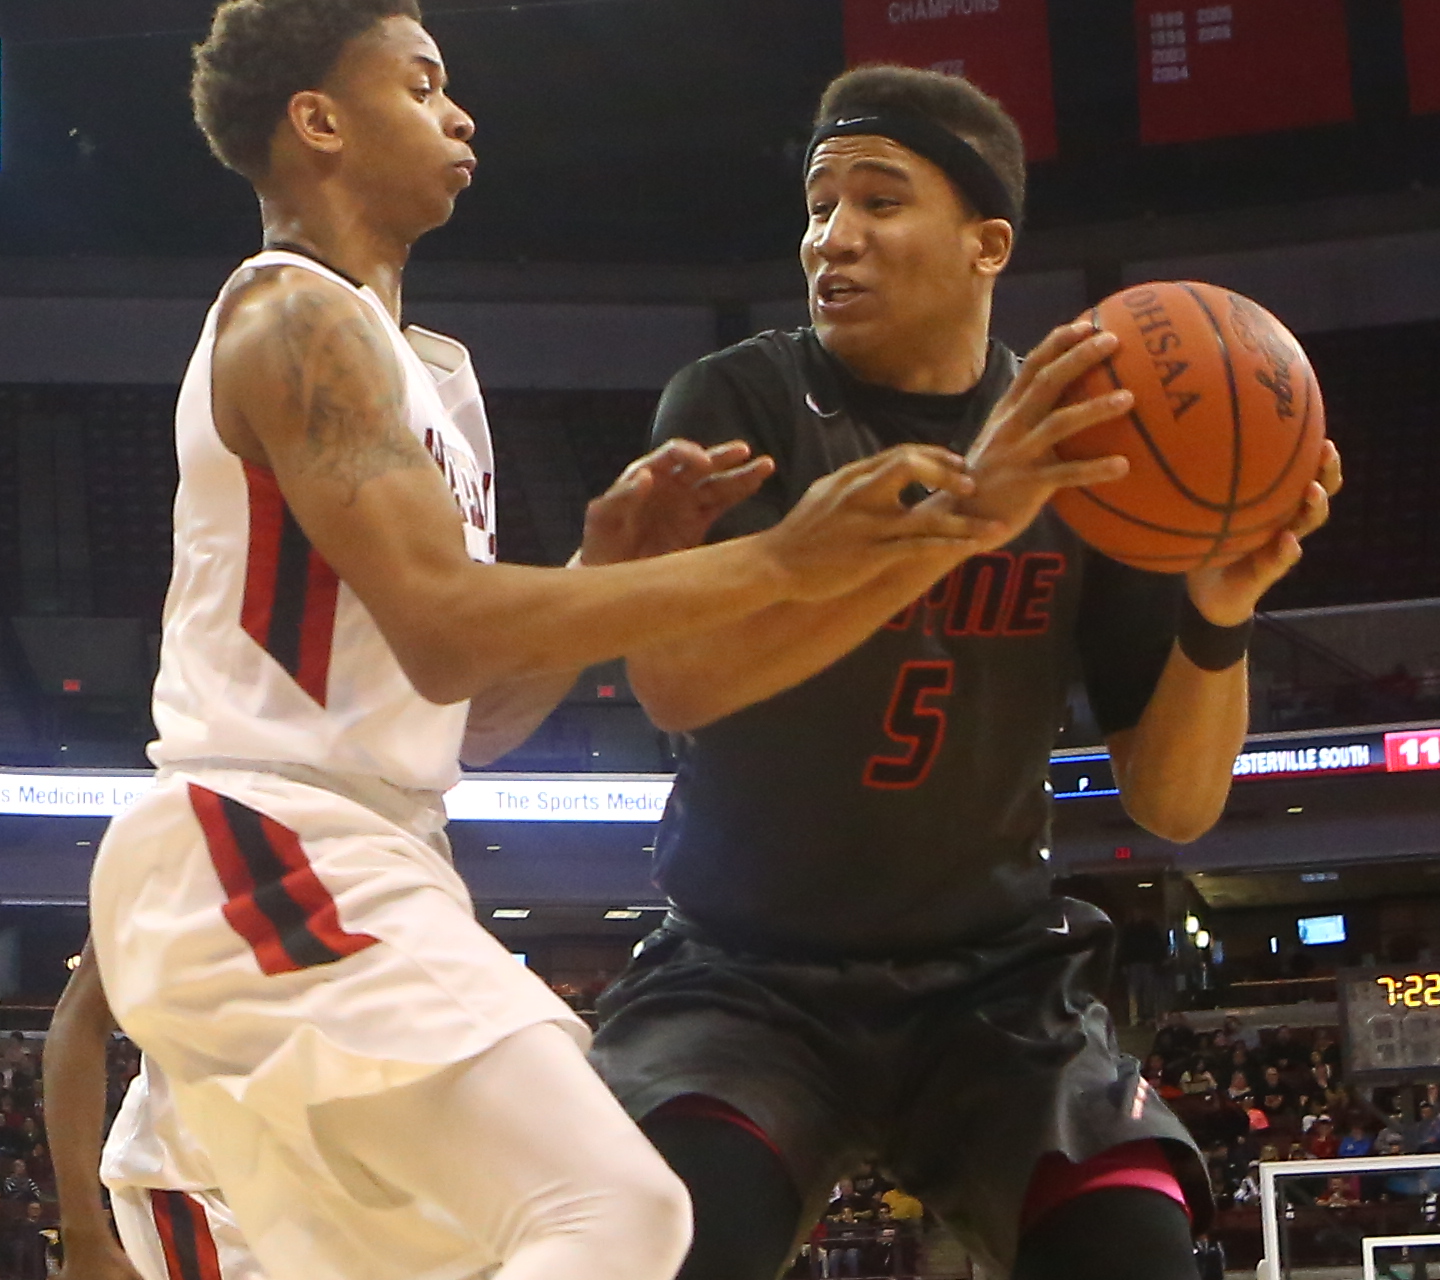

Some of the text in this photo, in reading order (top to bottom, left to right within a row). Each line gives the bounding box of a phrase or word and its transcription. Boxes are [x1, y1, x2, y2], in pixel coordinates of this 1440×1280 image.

[1122, 288, 1202, 422] OHSAA
[862, 659, 956, 790] 5
[1232, 745, 1370, 776] ESTERVILLE SOUTH
[1400, 736, 1440, 765] 11
[19, 785, 105, 805] Medicine
[495, 792, 670, 812] The Sports Medic
